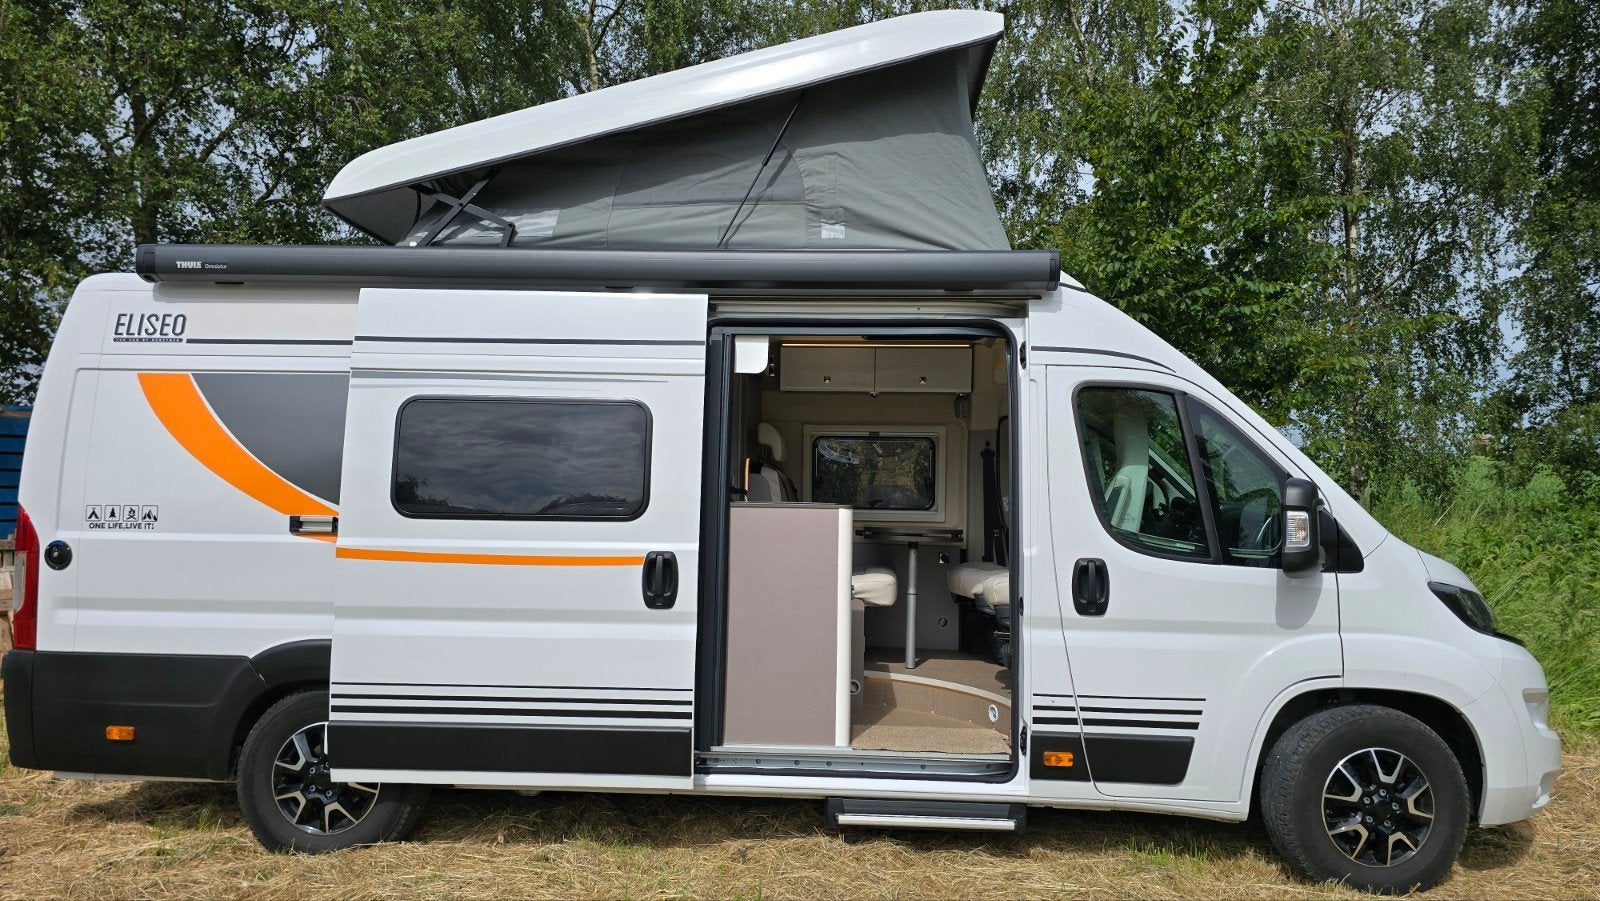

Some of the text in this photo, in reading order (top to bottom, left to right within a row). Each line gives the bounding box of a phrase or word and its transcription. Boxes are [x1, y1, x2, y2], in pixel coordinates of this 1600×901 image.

[175, 261, 202, 269] THULE
[114, 313, 187, 336] ELISEO
[144, 522, 155, 530] IT!
